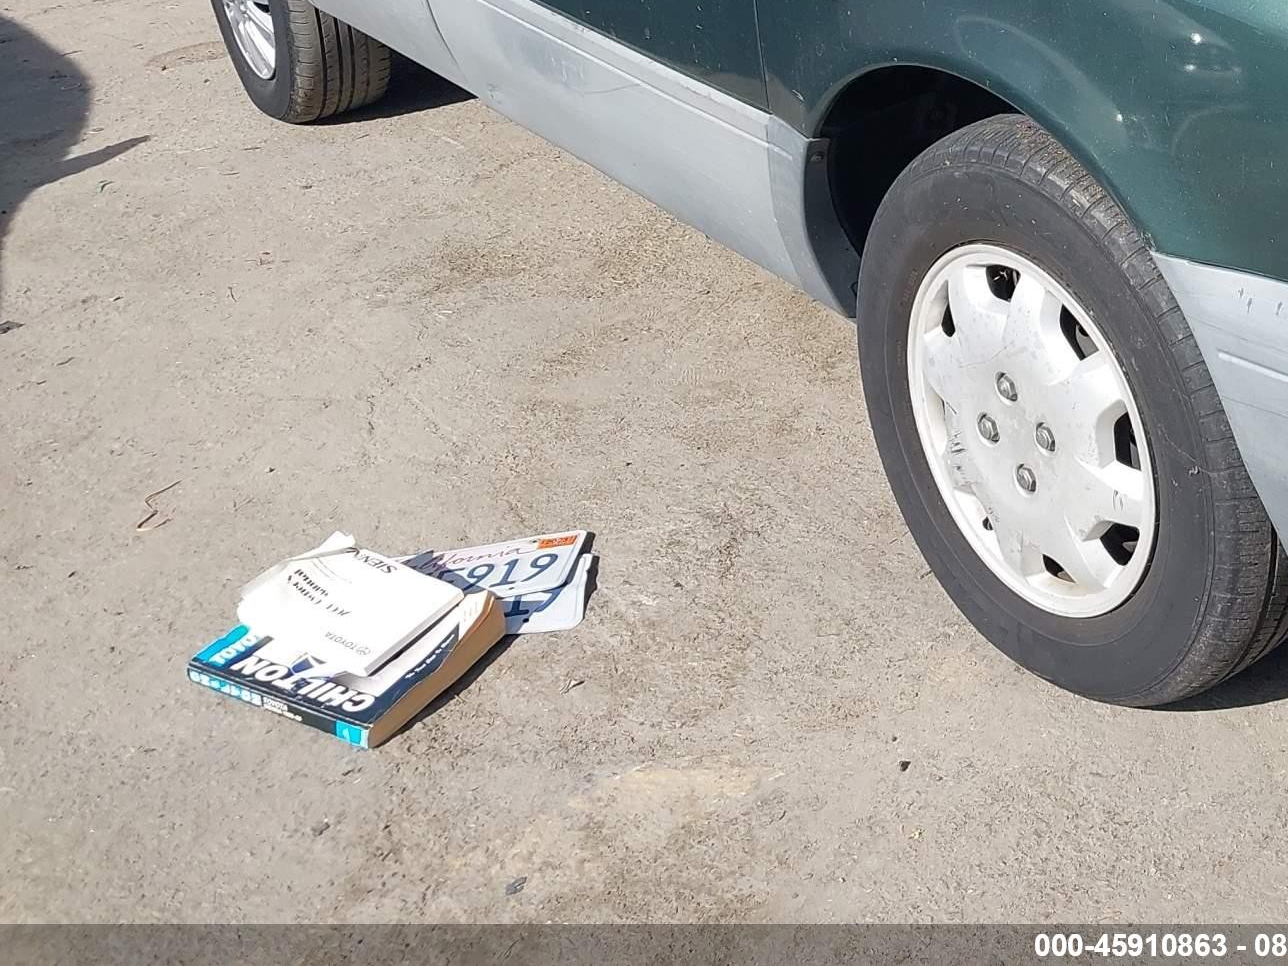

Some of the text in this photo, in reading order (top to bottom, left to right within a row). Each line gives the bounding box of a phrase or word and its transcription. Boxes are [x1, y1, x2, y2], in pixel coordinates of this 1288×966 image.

[210, 635, 257, 666] TOYO
[325, 631, 358, 651] TOYOTA
[229, 654, 376, 712] CHILTON
